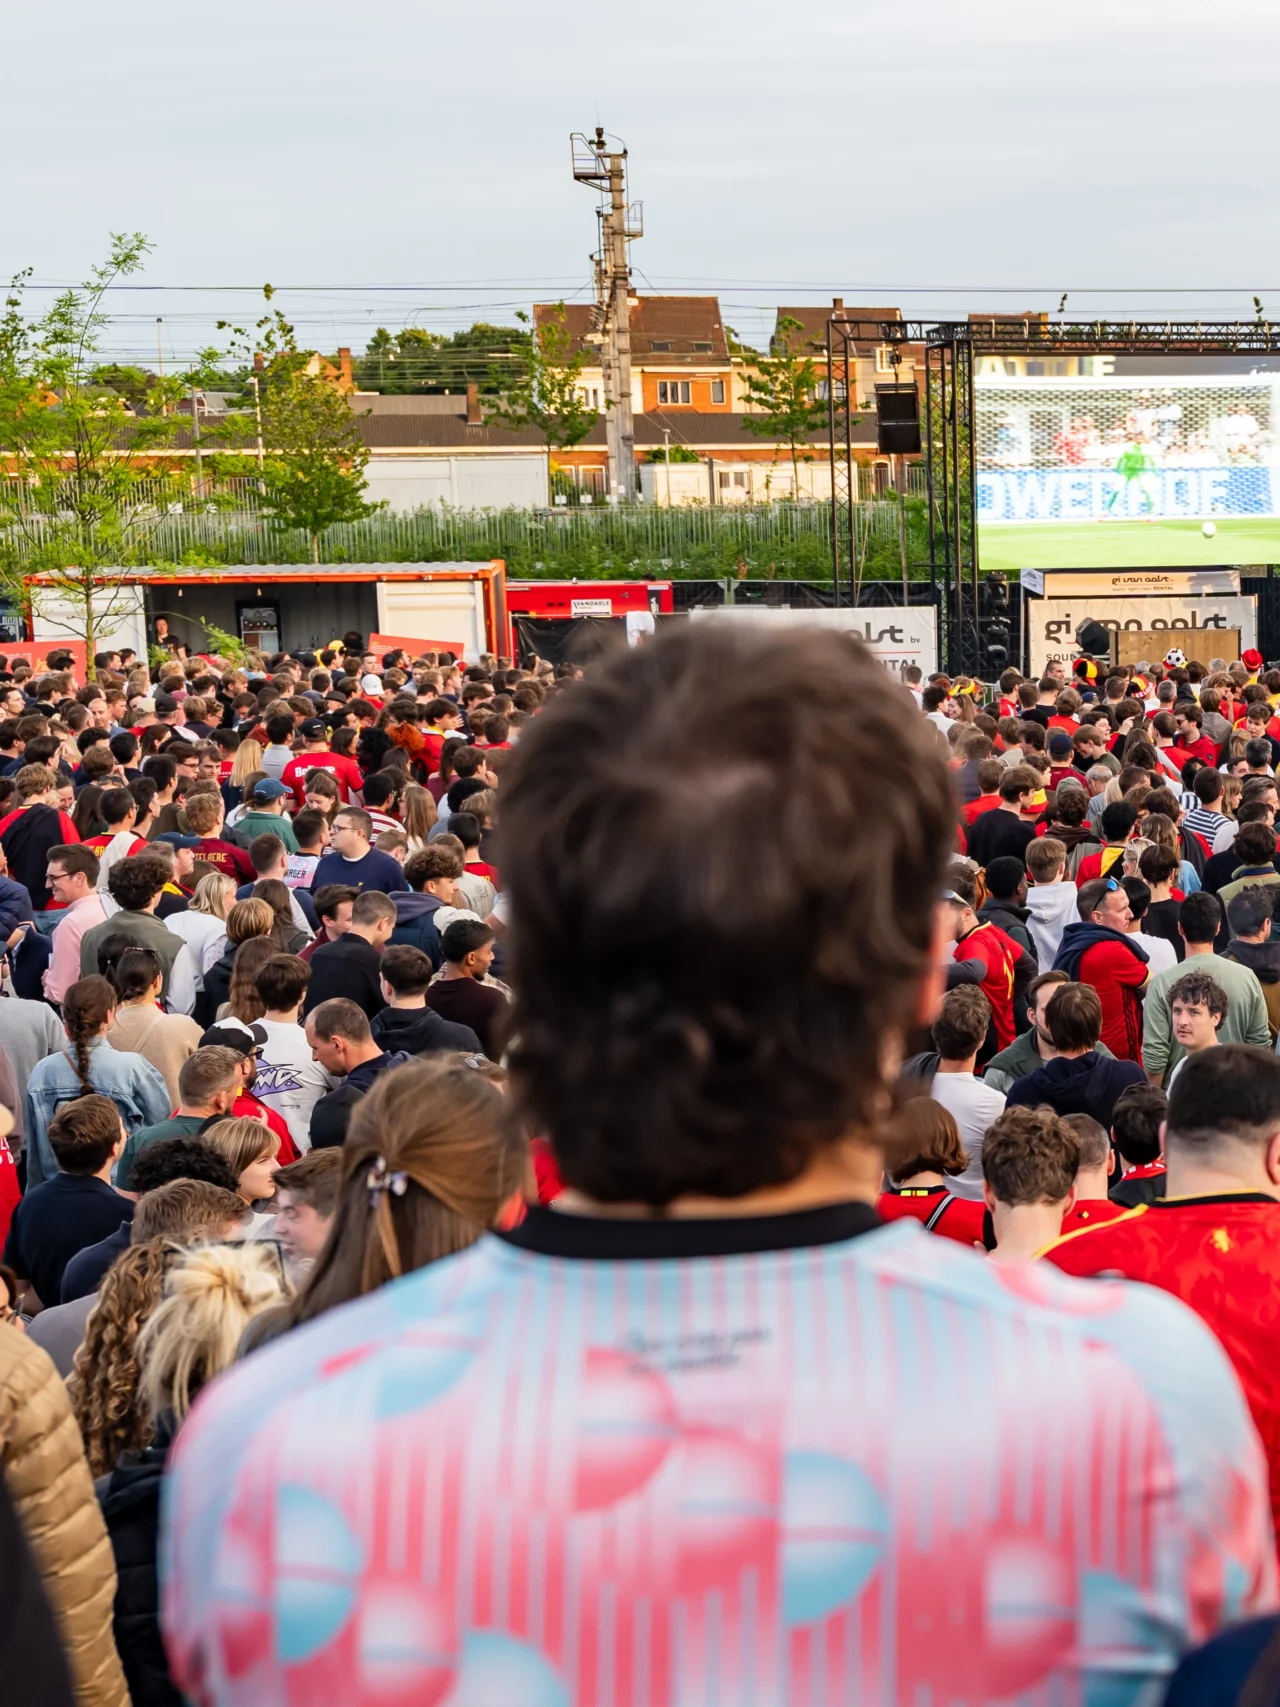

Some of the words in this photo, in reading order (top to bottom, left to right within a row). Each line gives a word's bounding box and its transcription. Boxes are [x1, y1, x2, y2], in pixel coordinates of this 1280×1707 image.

[845, 622, 904, 644] alst
[1044, 613, 1071, 644] gi
[1150, 611, 1227, 630] aalst
